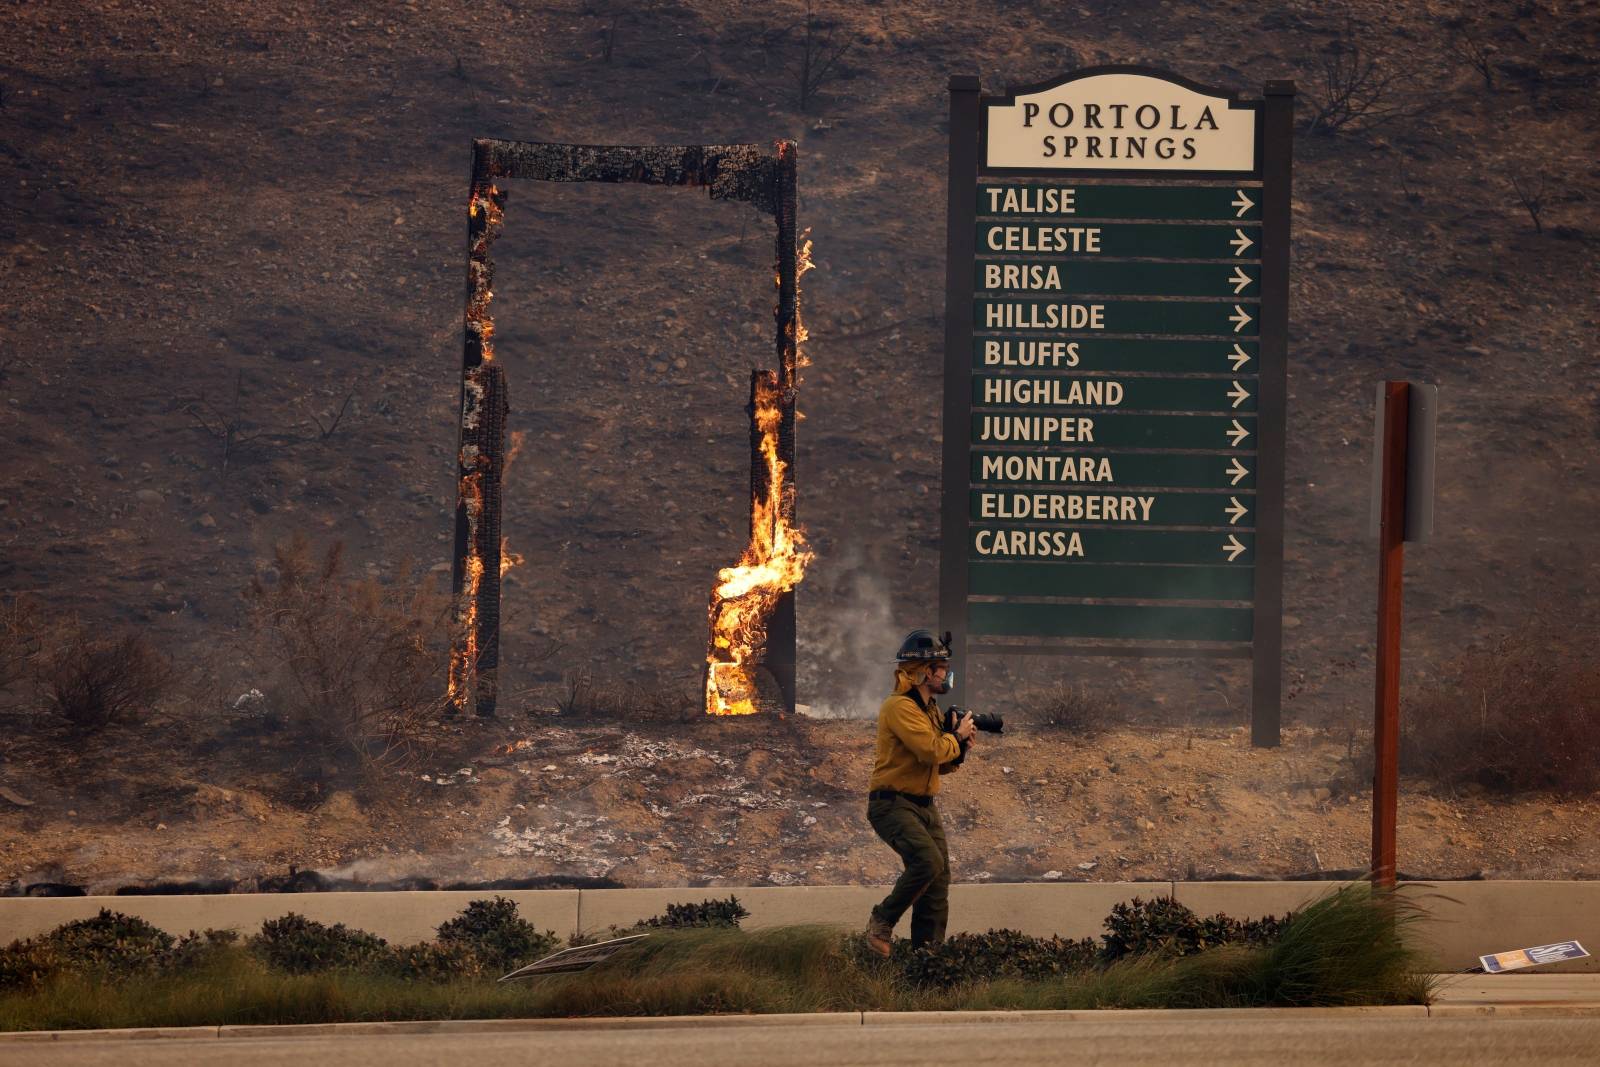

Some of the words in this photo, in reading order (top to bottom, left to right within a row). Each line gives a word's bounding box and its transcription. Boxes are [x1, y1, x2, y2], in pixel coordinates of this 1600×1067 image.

[1024, 103, 1219, 130] PORTOLA
[1043, 136, 1196, 159] SPRINGS
[987, 189, 1075, 213] TALISE
[988, 227, 1100, 251] CELESTE
[986, 265, 1061, 289] BRISA
[987, 304, 1104, 328] HILLSIDE
[985, 341, 1079, 366] BLUFFS
[985, 379, 1123, 405] HIGHLAND
[981, 417, 1093, 441] JUNIPER
[983, 456, 1113, 481] MONTARA
[982, 494, 1154, 520] ELDERBERRY
[976, 531, 1084, 556] CARISSA
